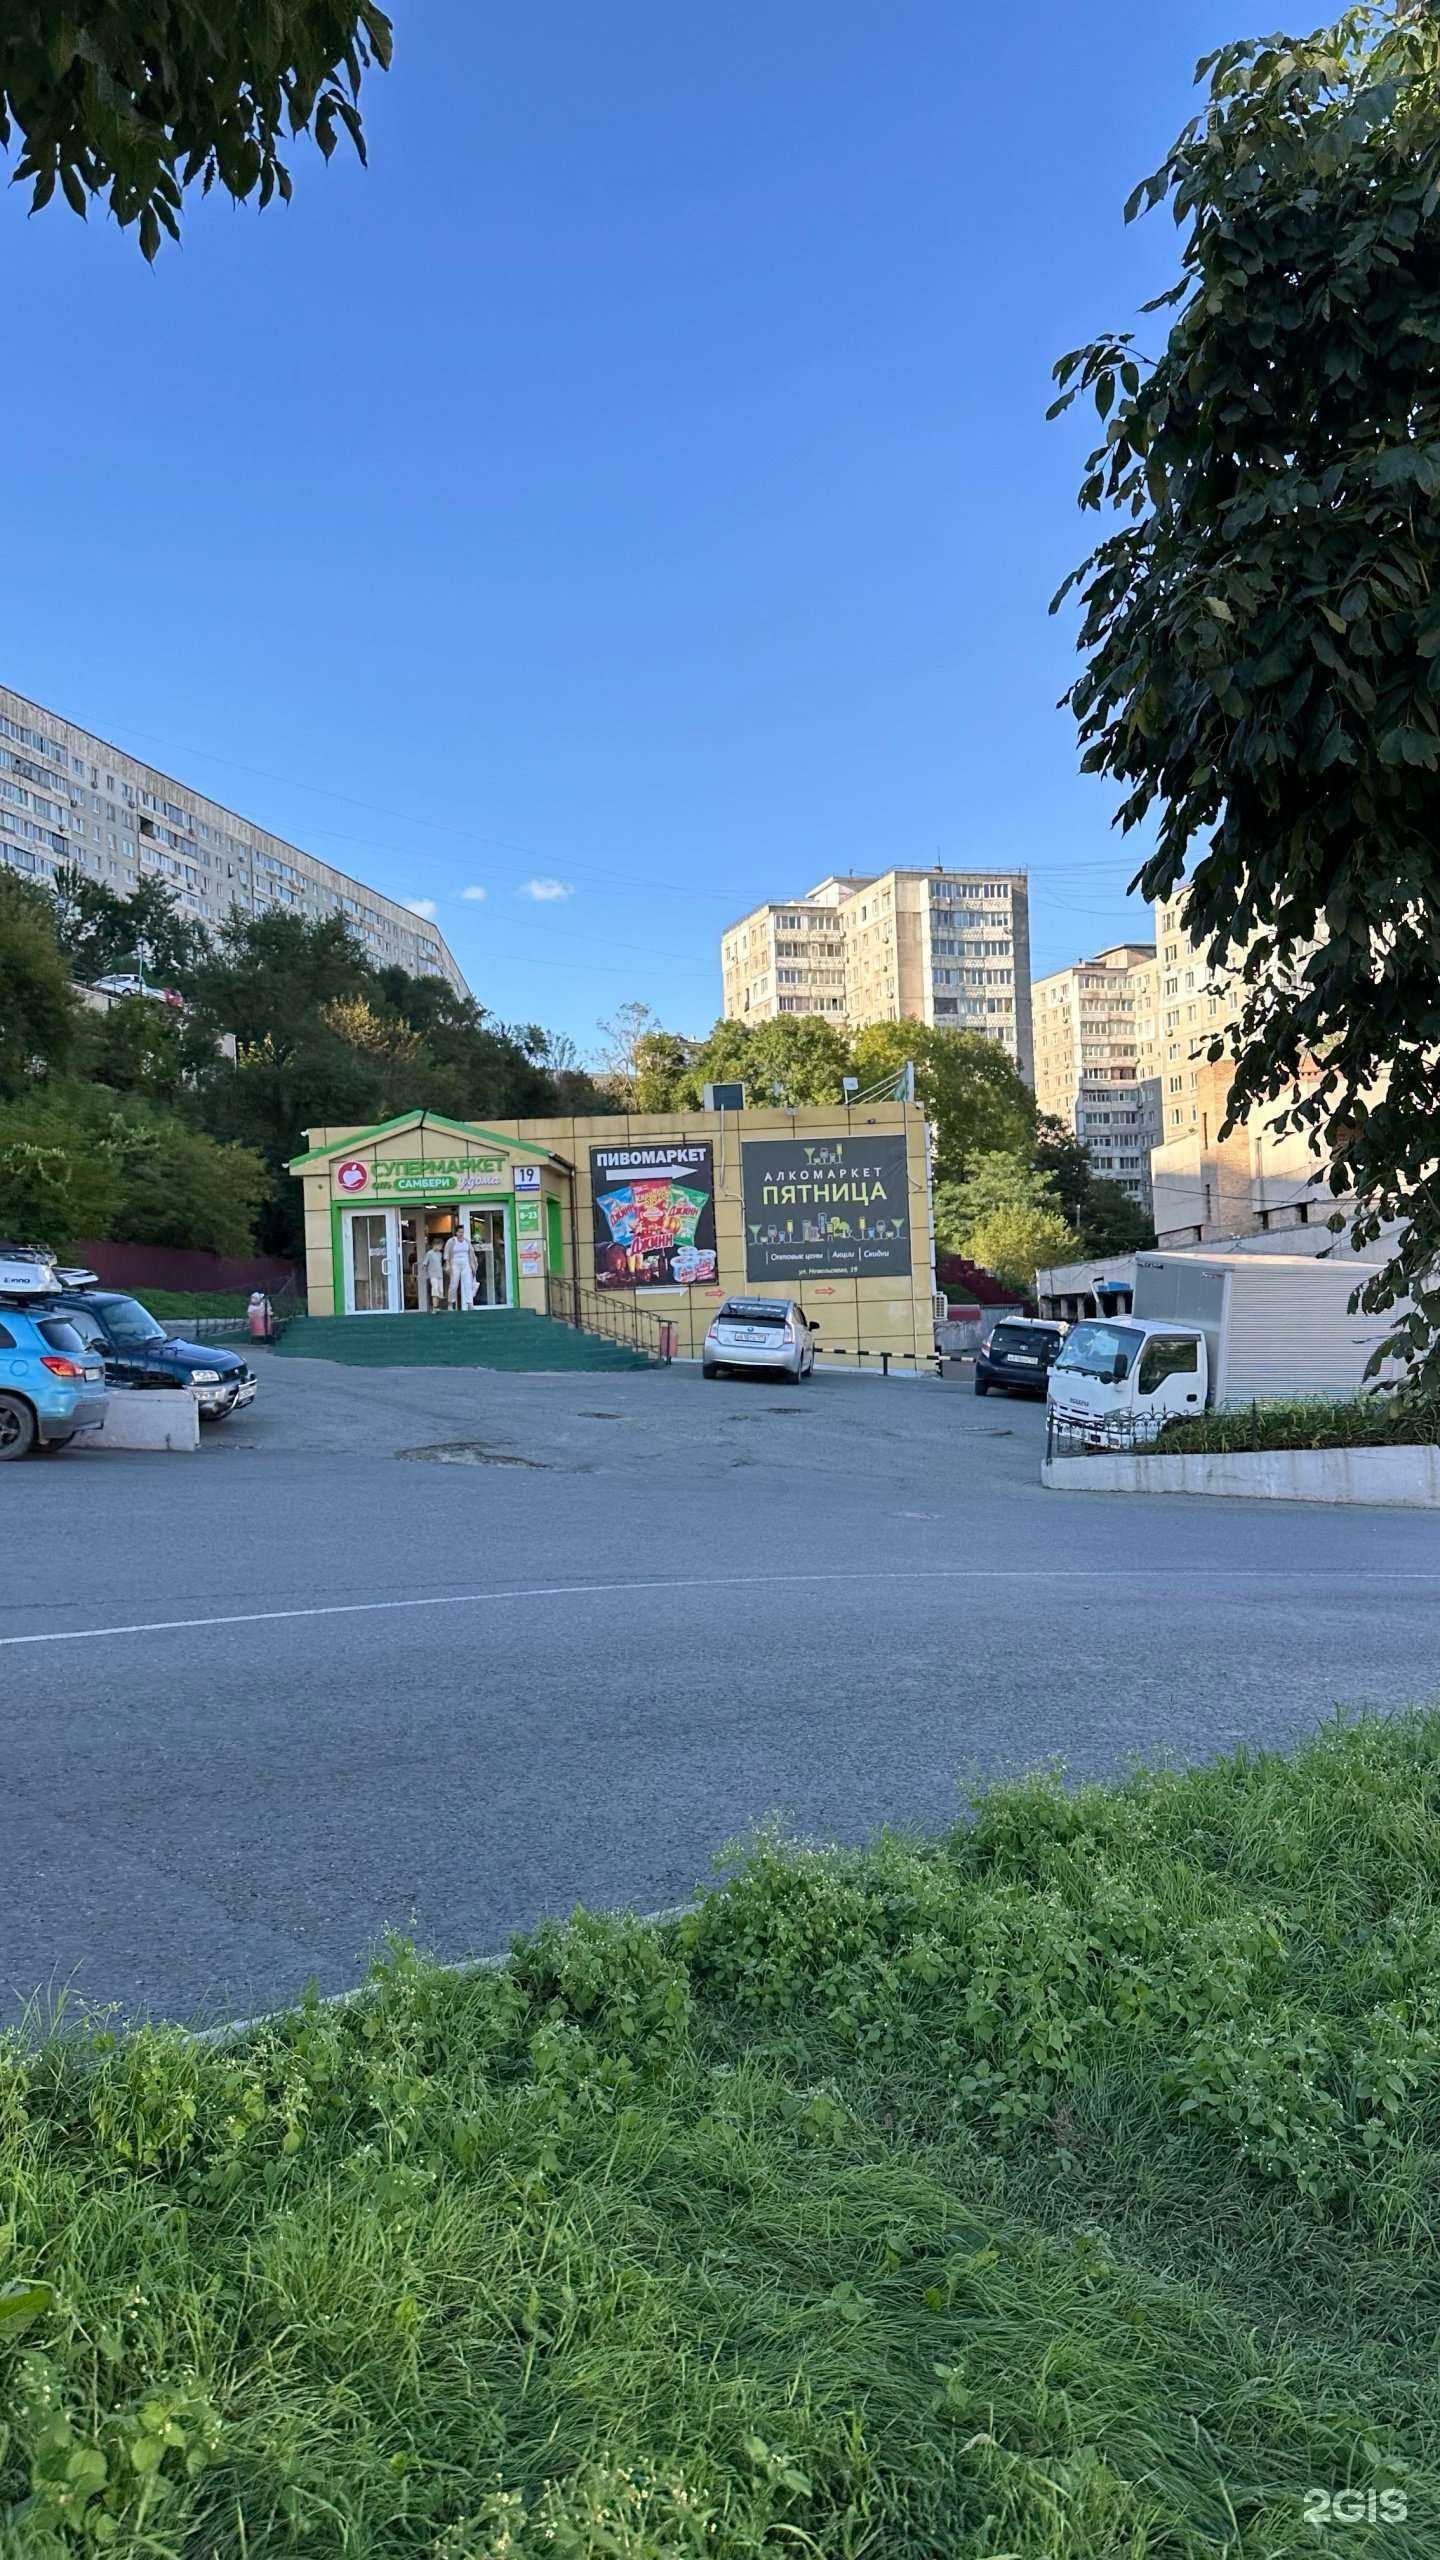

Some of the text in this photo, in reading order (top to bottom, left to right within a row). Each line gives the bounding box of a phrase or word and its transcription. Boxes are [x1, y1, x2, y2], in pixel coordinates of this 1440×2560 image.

[596, 1148, 707, 1167] ПИВОМАРКЕТ
[371, 1157, 506, 1178] СУПЕРМАРКЕТ
[520, 1168, 534, 1182] 19
[764, 1167, 882, 1182] АЛКОМАРКЕТ
[398, 1177, 450, 1189] САМБЕРИ
[762, 1181, 887, 1206] ПЯТНИЦА
